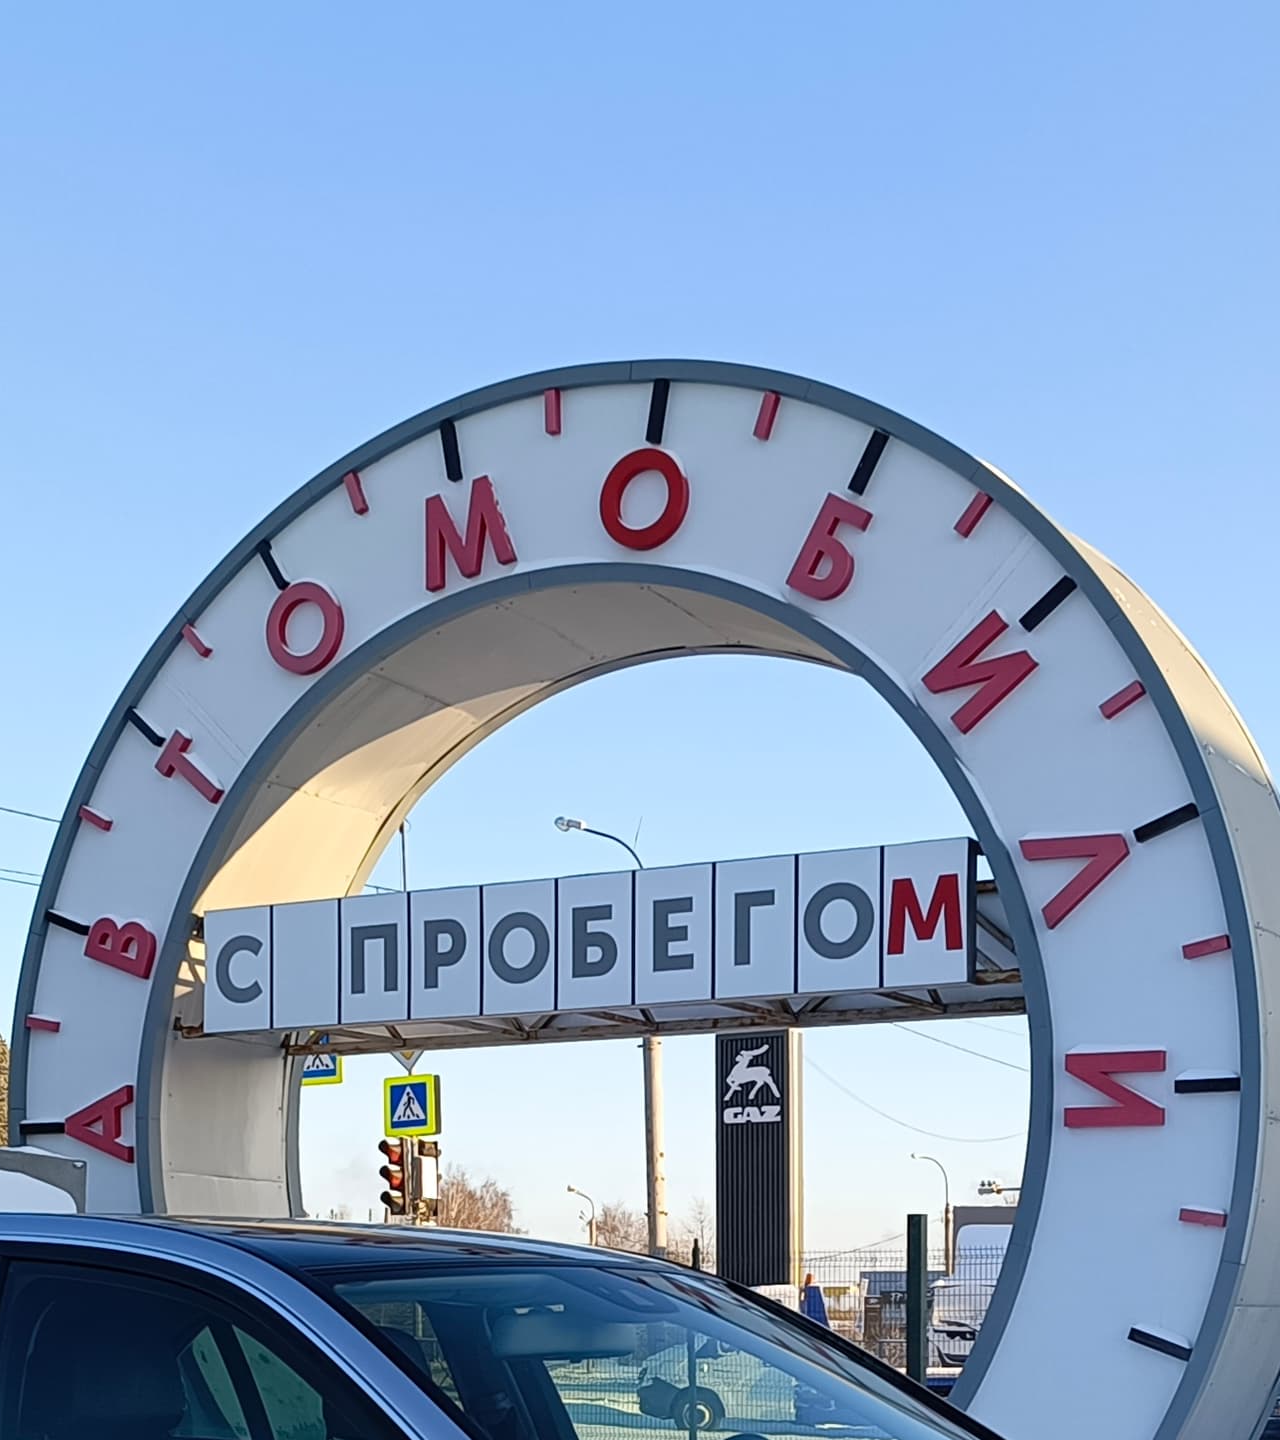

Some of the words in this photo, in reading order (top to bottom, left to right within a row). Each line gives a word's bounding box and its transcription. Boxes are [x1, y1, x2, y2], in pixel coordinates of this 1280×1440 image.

[64, 446, 1167, 1165] АВТОМОБИЛИ
[214, 934, 264, 1004] С
[349, 873, 964, 996] ПРОБЕГОМ
[723, 1105, 782, 1124] GAZ
